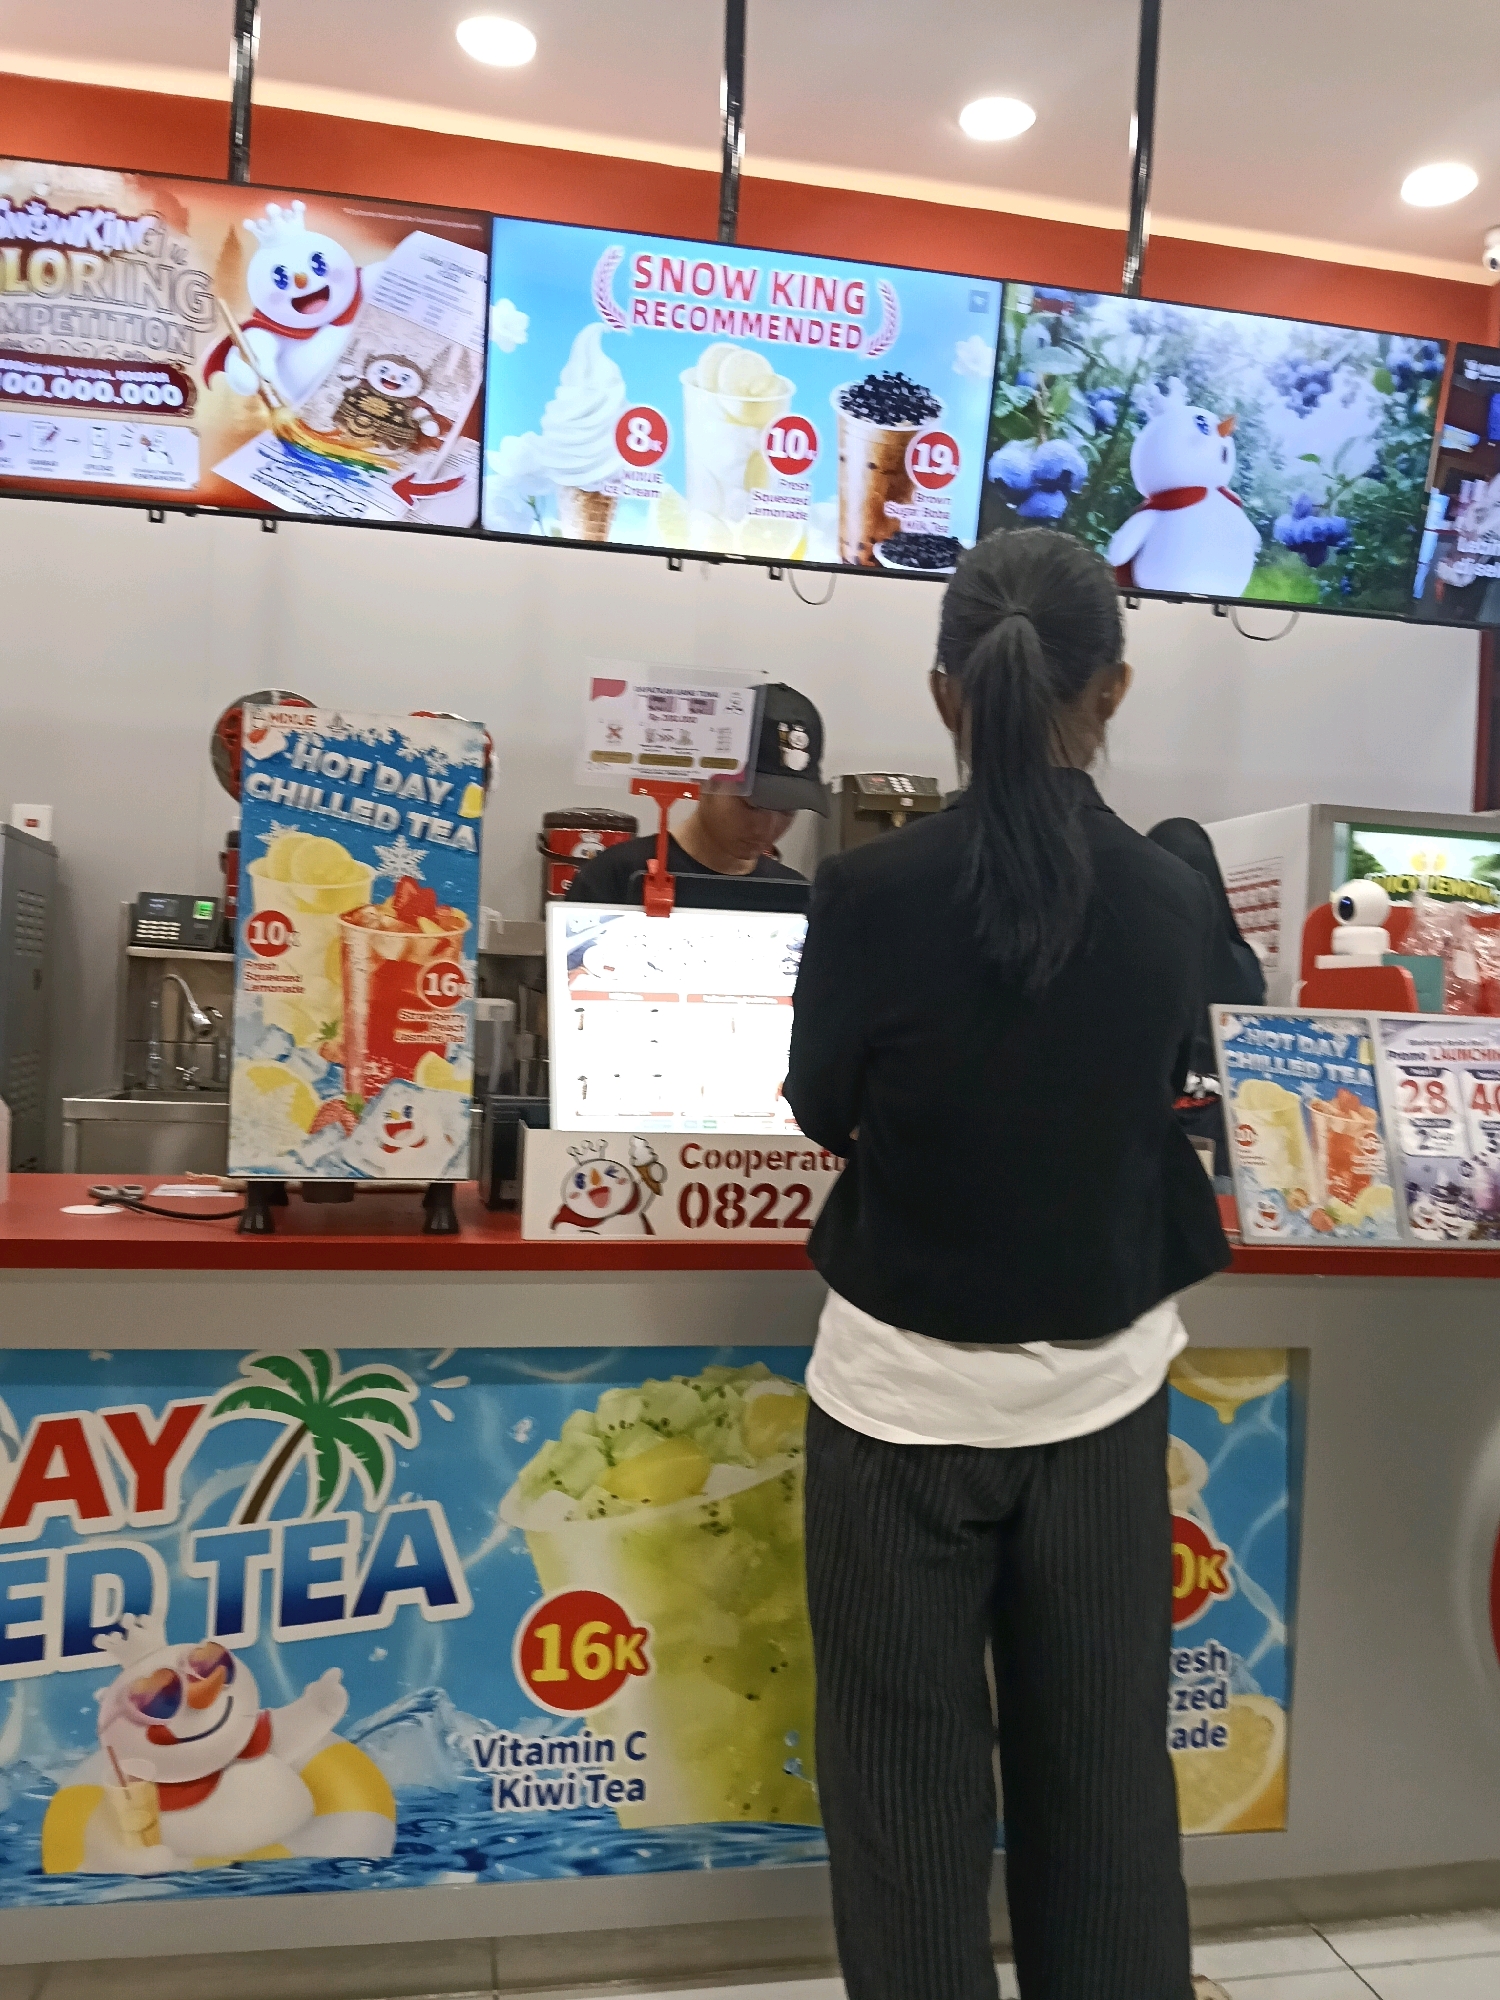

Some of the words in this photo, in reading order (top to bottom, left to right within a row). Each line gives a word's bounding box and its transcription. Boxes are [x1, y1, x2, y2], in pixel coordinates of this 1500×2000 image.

[634, 254, 759, 302] SNOW
[773, 270, 865, 316] KING
[633, 298, 863, 350] RECOMMENDED
[290, 740, 372, 785] HOT
[373, 761, 454, 808] DAY
[245, 772, 401, 833] CHILLED
[406, 810, 478, 853] TEA
[1224, 1050, 1323, 1080] CHILLED
[1323, 1062, 1375, 1087] TEA
[1244, 1027, 1296, 1051] HOT
[1296, 1033, 1349, 1058] DAY
[1399, 1079, 1448, 1115] 28
[679, 1181, 815, 1230] 0822
[0, 1403, 207, 1529] AY
[193, 1508, 460, 1637] TEA
[530, 1620, 646, 1682] 16K
[473, 1729, 615, 1768] Vitamin
[625, 1730, 648, 1762] C
[499, 1772, 577, 1809] Kiwi
[585, 1773, 646, 1803] Tea
